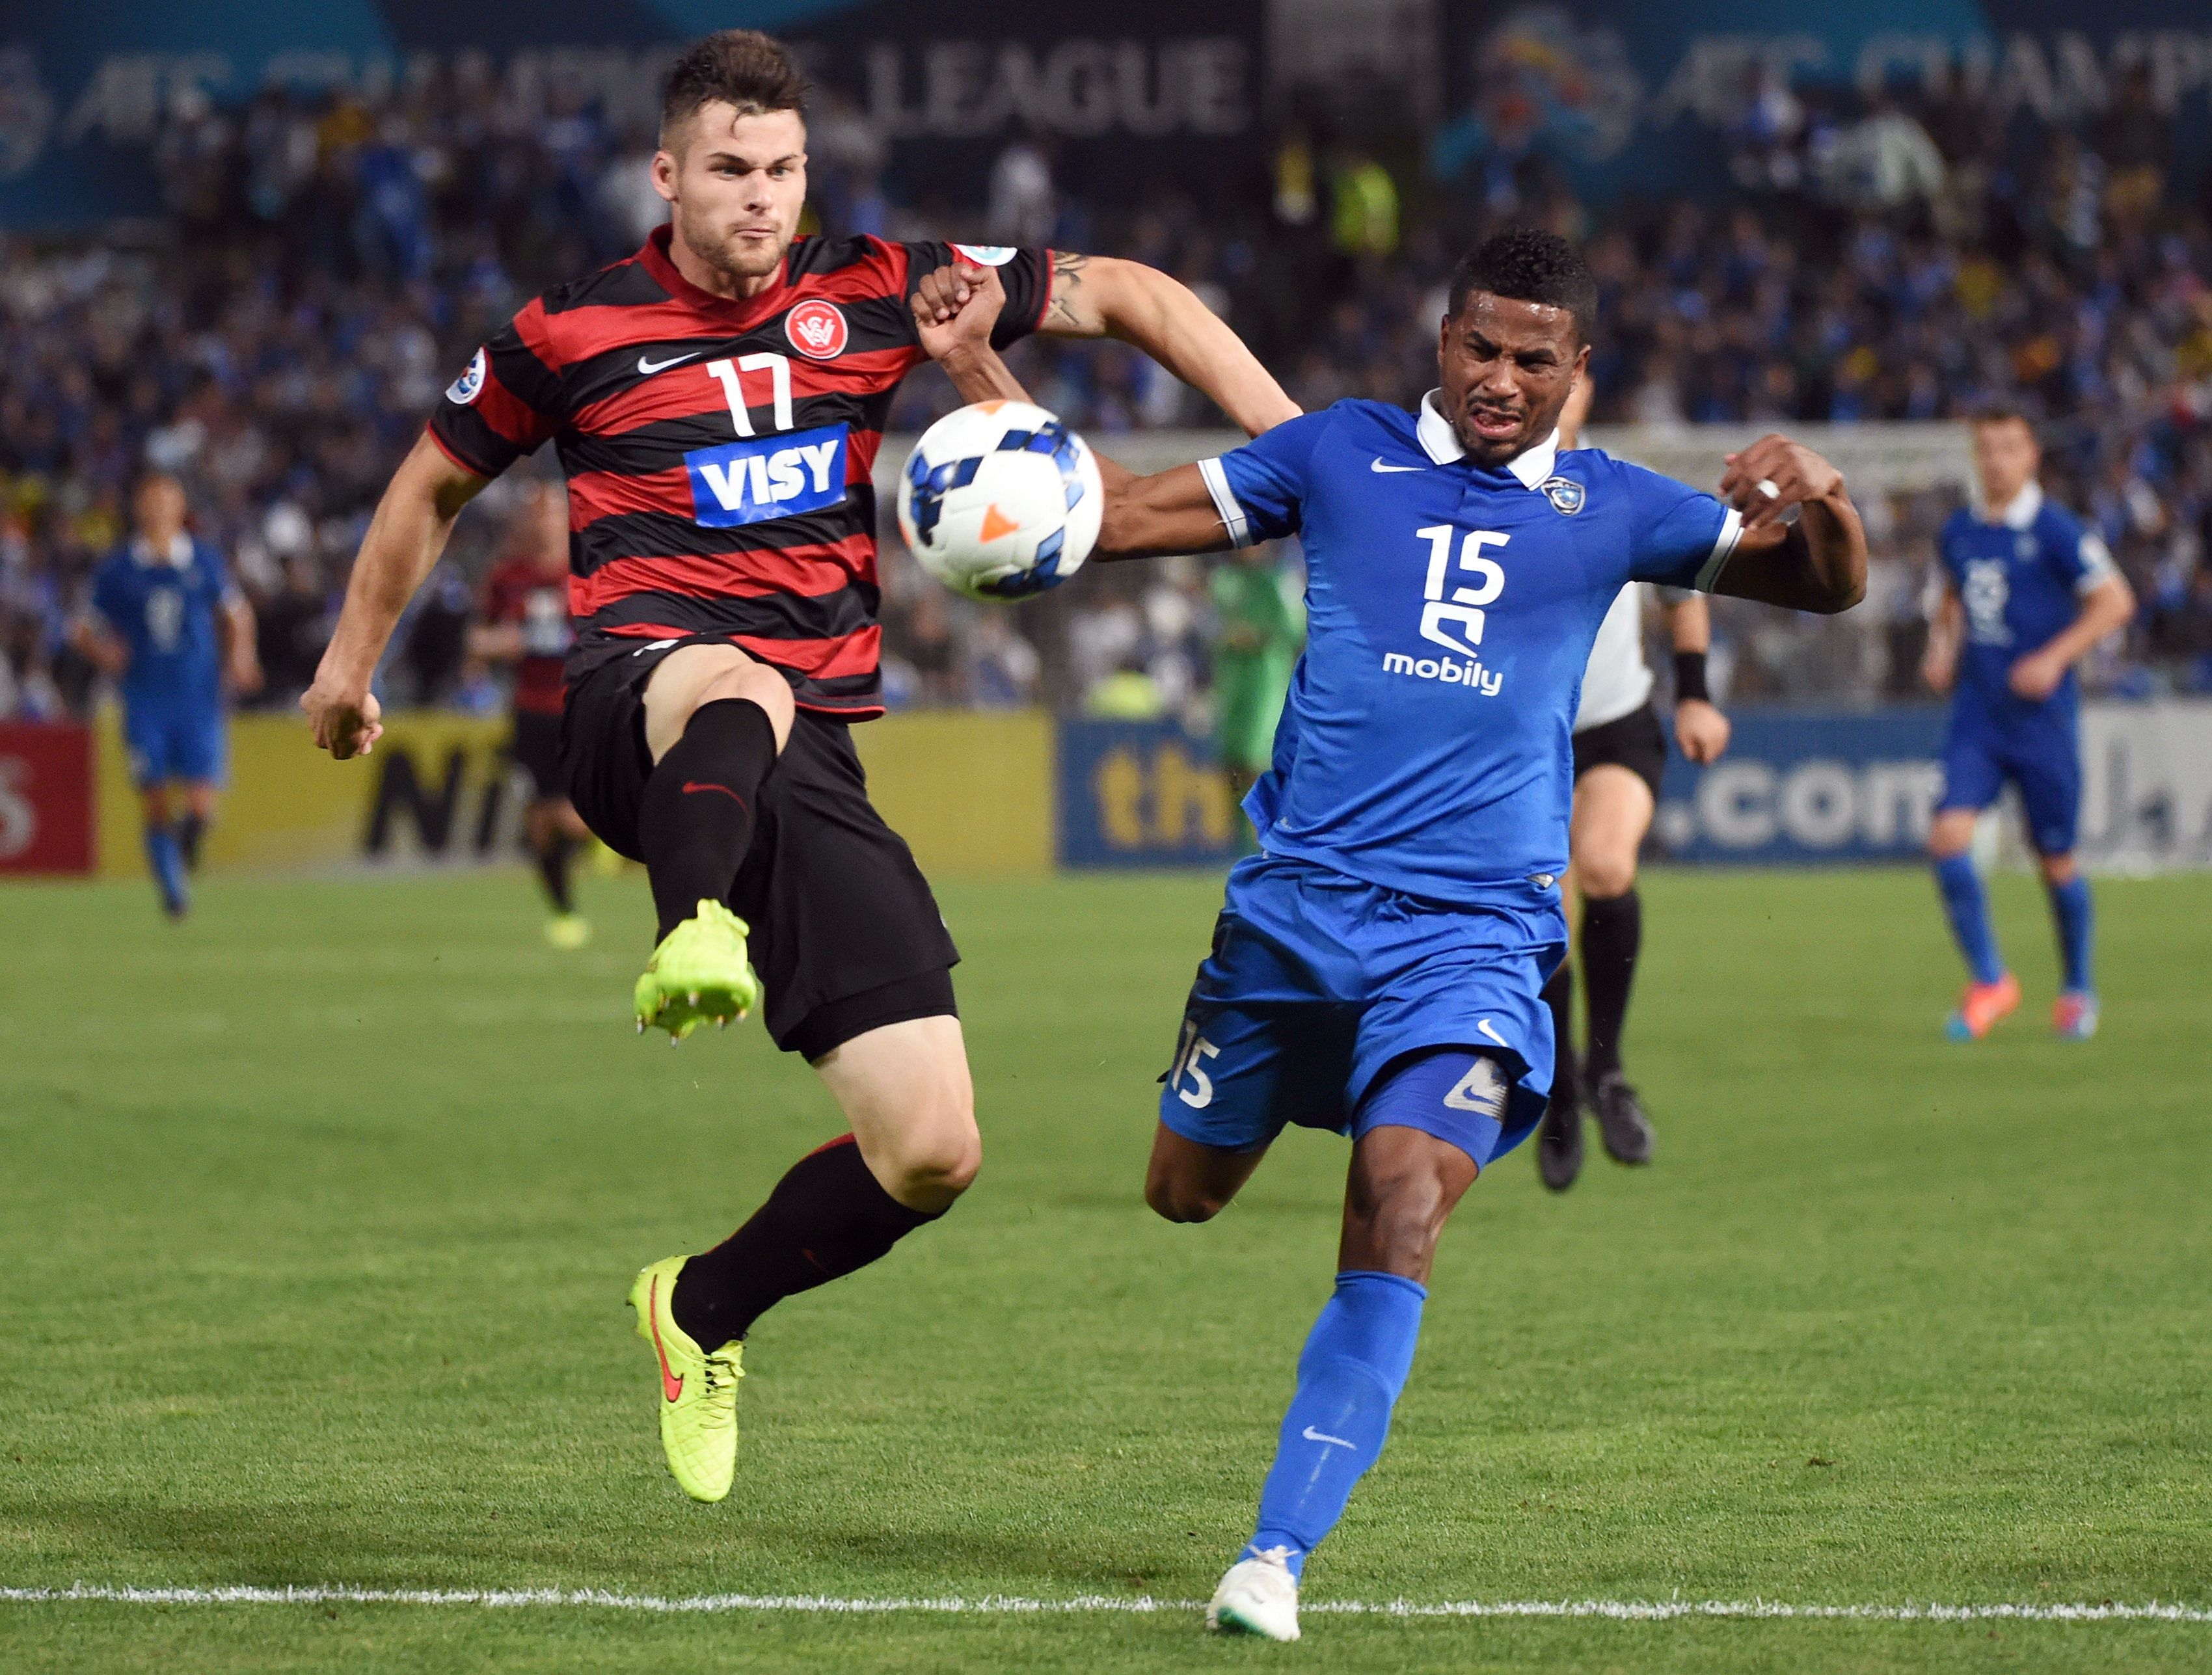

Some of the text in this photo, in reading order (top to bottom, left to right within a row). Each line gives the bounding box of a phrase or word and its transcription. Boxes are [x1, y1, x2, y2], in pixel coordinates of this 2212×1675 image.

[864, 38, 1248, 137] LEAGUE
[706, 352, 794, 437] 17
[698, 439, 839, 511] VISY
[1416, 524, 1511, 606] 15
[1382, 652, 1503, 697] mobily
[1172, 1019, 1221, 1109] 15
